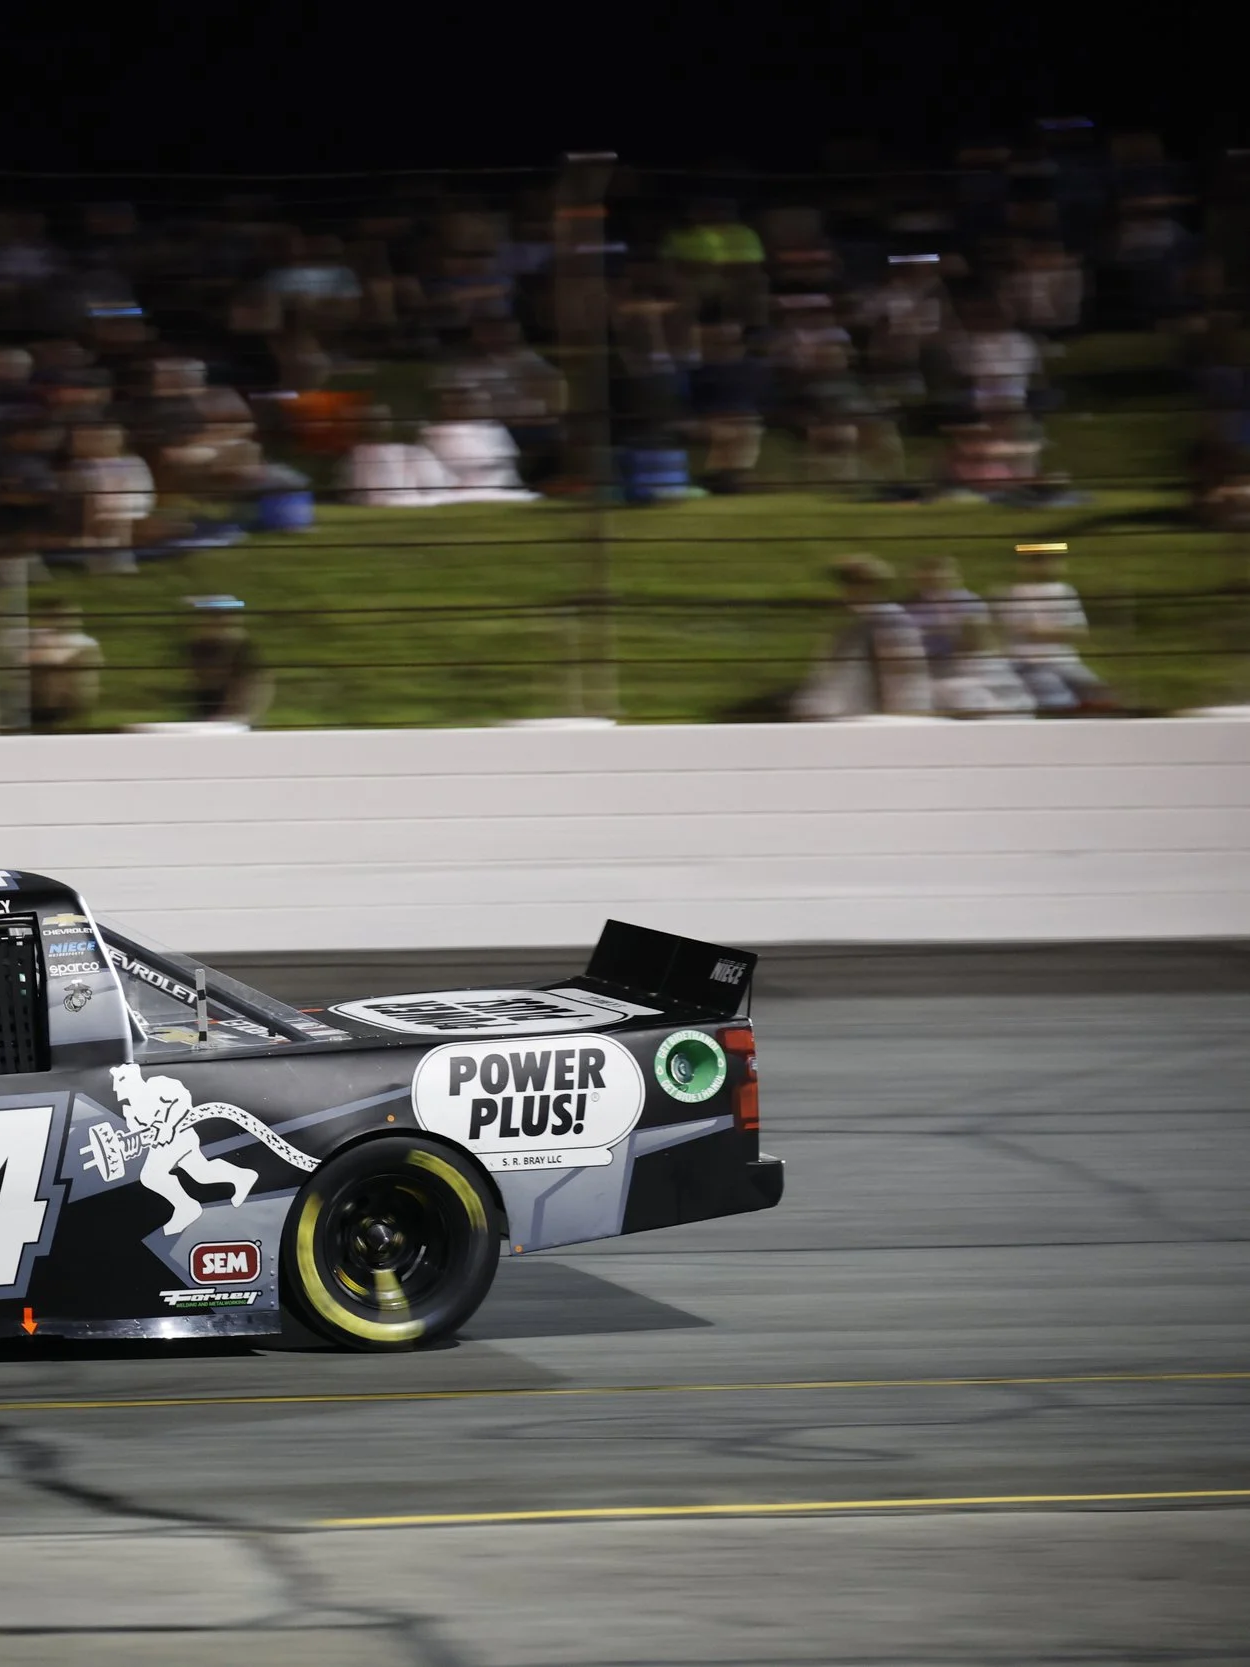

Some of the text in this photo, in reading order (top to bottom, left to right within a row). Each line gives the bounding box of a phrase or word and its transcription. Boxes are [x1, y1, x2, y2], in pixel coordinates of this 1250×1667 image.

[43, 927, 94, 936] CHEVROLET
[49, 941, 96, 954] NIECE
[109, 950, 198, 1004] EVROLET
[448, 1047, 607, 1096] POWER
[468, 1093, 587, 1140] PLUS!
[502, 1155, 562, 1167] S. R. BRAY LLC
[202, 1251, 249, 1275] SEM
[159, 1288, 258, 1306] Forney
